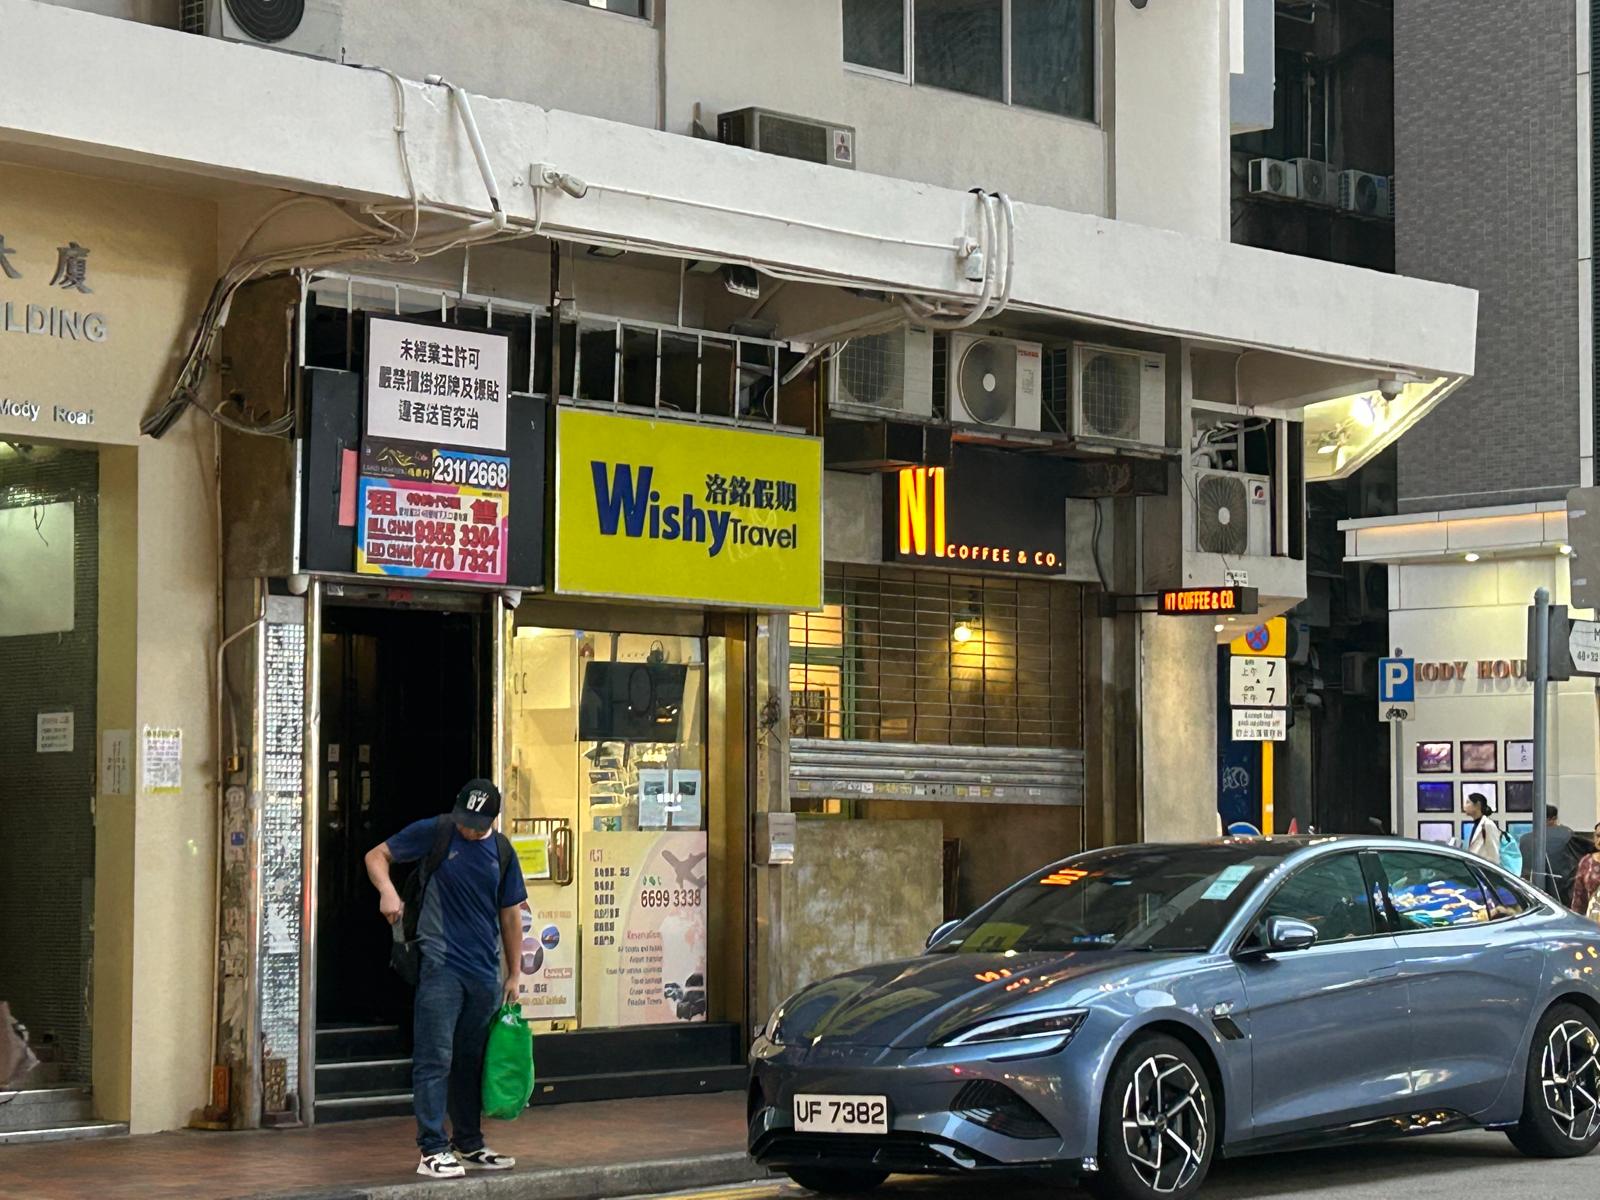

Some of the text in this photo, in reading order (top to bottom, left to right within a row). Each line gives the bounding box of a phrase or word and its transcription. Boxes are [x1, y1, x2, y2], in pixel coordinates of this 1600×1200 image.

[400, 338, 480, 370] 未經業主許可
[433, 456, 466, 484] 2311
[469, 461, 508, 489] 2668
[590, 461, 797, 558] Wishy Travel
[947, 544, 1010, 563] COFFEE
[1018, 550, 1027, 564] &
[1034, 552, 1062, 567] CO.
[1177, 590, 1211, 610] COFFEE
[1266, 661, 1276, 677] 7
[1385, 663, 1408, 698] P
[1477, 660, 1528, 680] HOU
[1266, 687, 1276, 703] 7
[640, 889, 702, 908] 6699 3338
[796, 1100, 885, 1125] UF 7382
